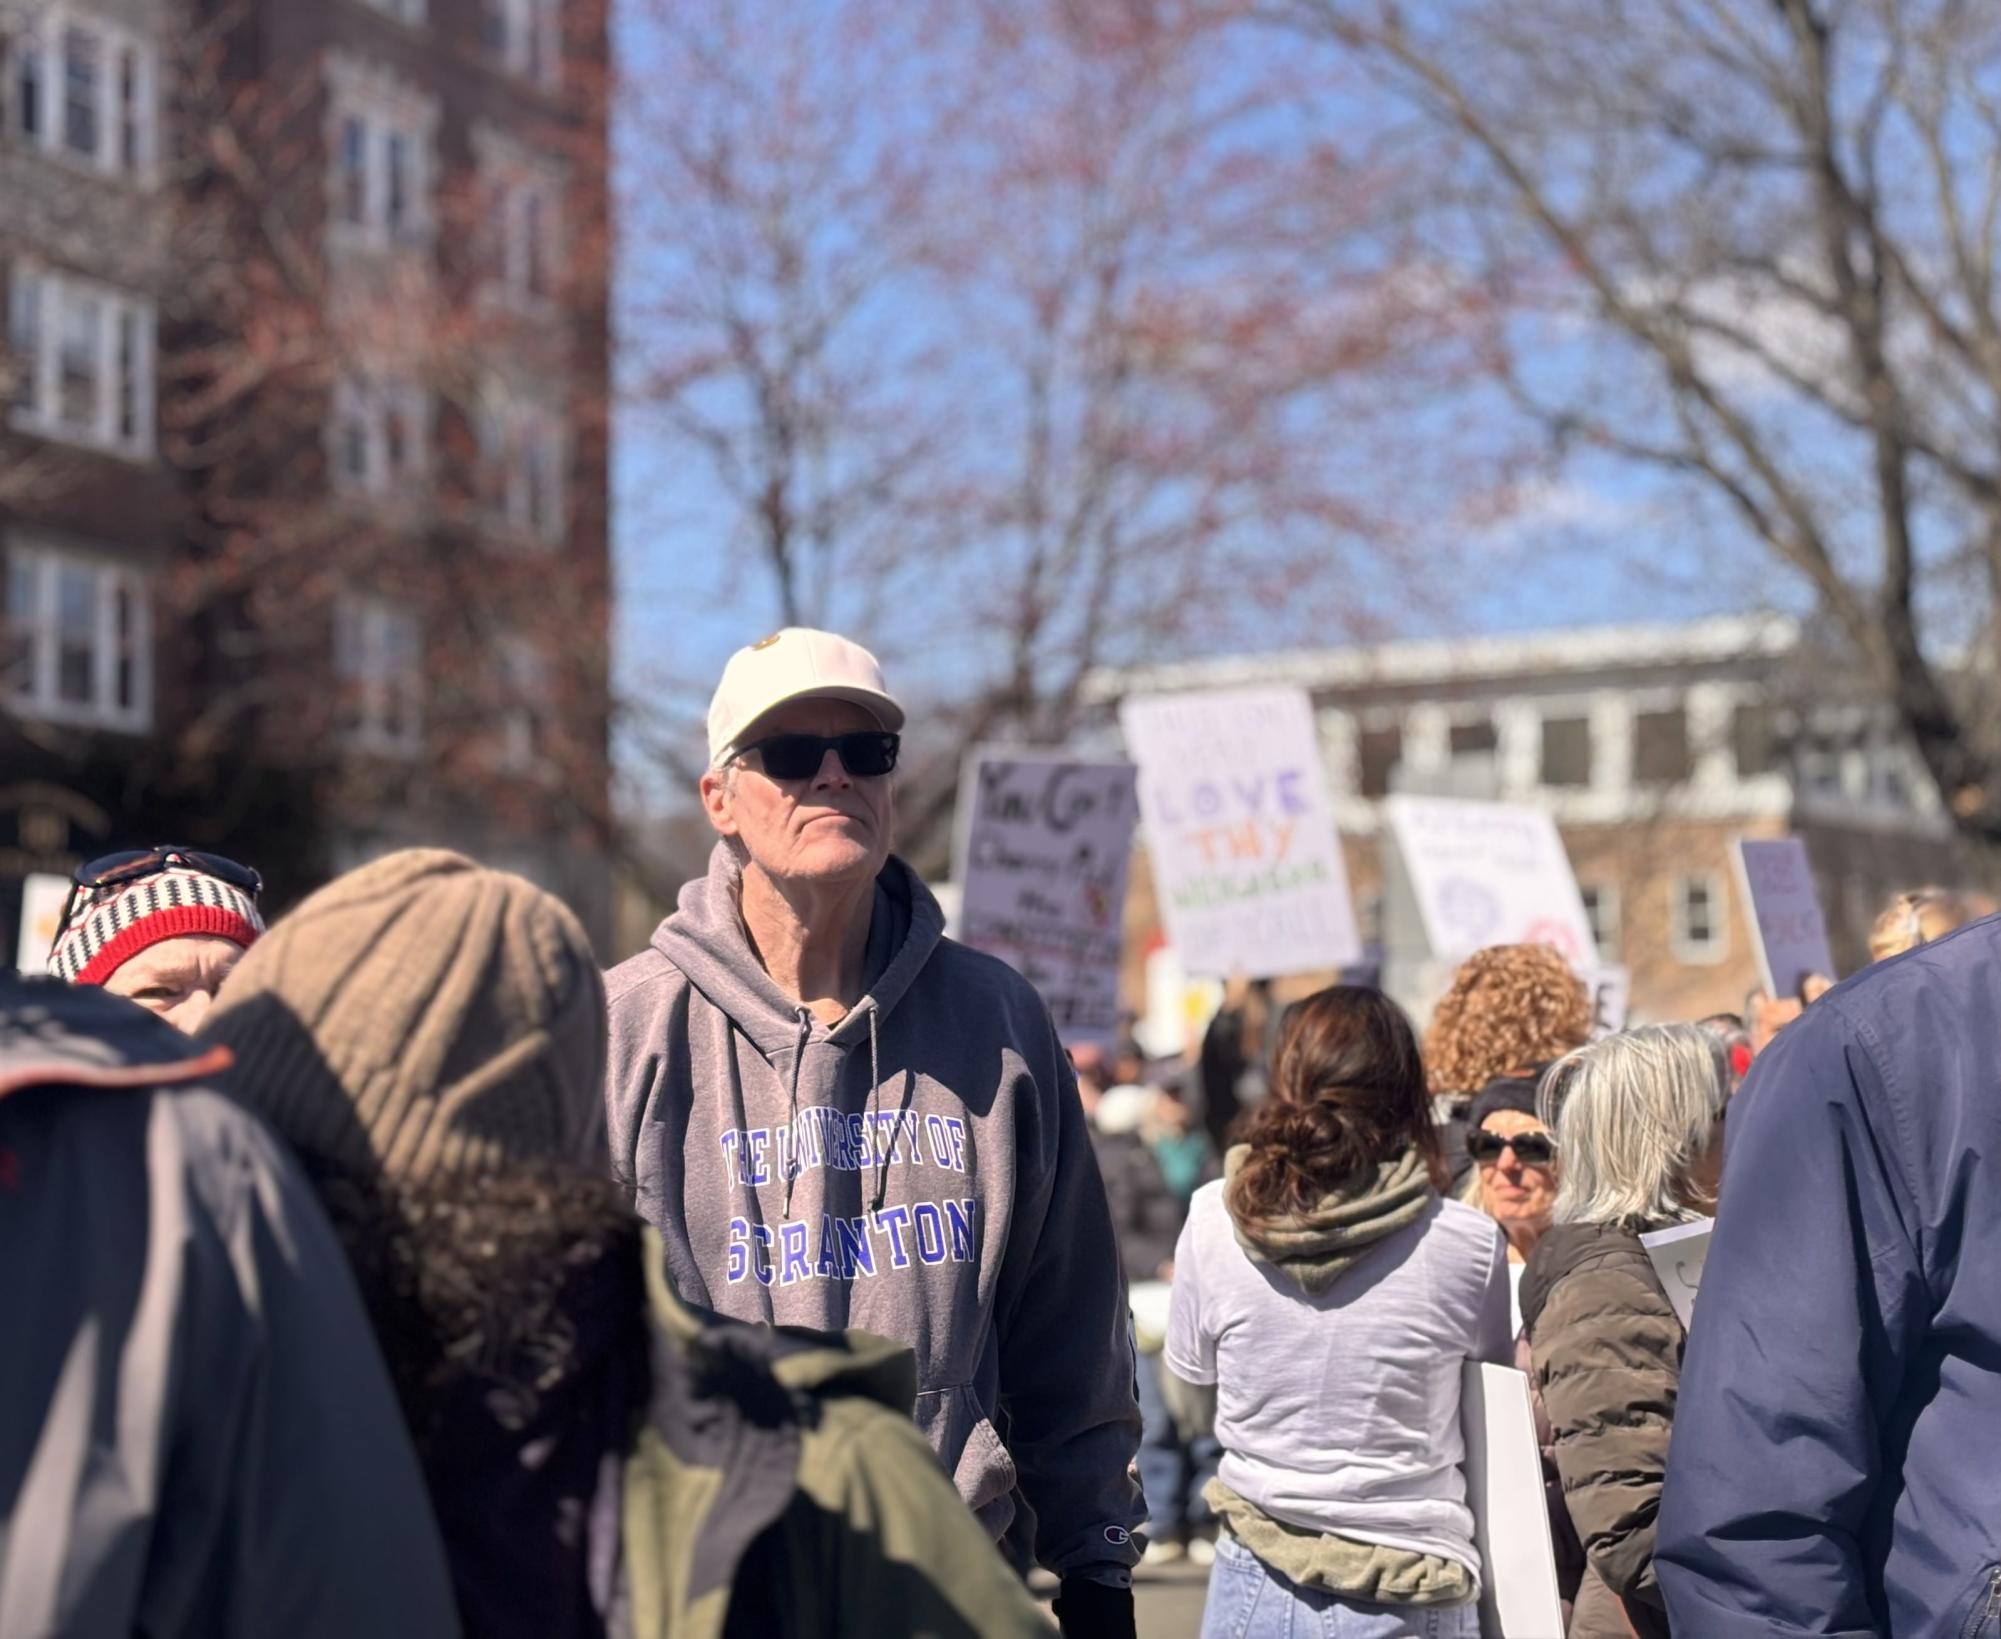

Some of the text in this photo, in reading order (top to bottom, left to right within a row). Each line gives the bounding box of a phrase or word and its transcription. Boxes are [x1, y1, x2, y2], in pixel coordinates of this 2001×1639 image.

[1153, 767, 1310, 826] LOVE
[1181, 816, 1297, 867] THY
[719, 1106, 966, 1194] THE UNIVERSITY OF
[726, 1199, 976, 1288] SCRANTON
